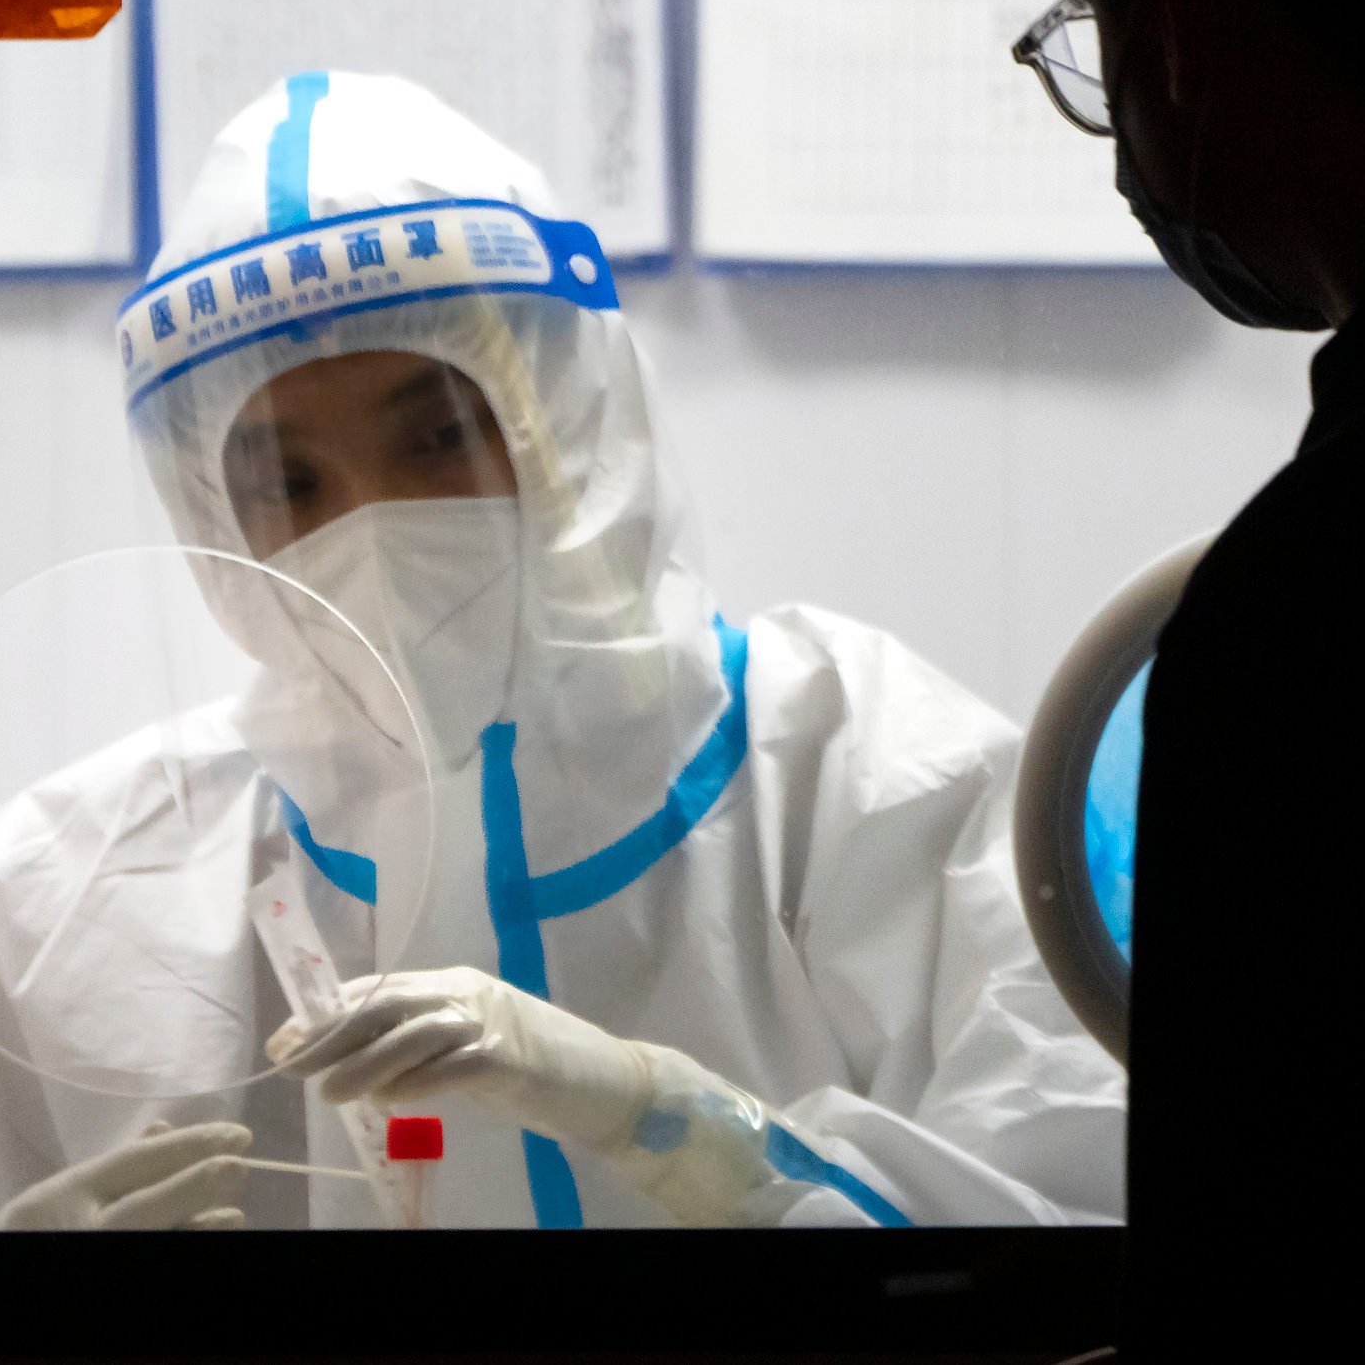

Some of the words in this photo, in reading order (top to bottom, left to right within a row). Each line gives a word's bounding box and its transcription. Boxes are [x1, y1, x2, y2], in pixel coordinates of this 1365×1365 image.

[148, 218, 444, 342] 医用隔离面罩
